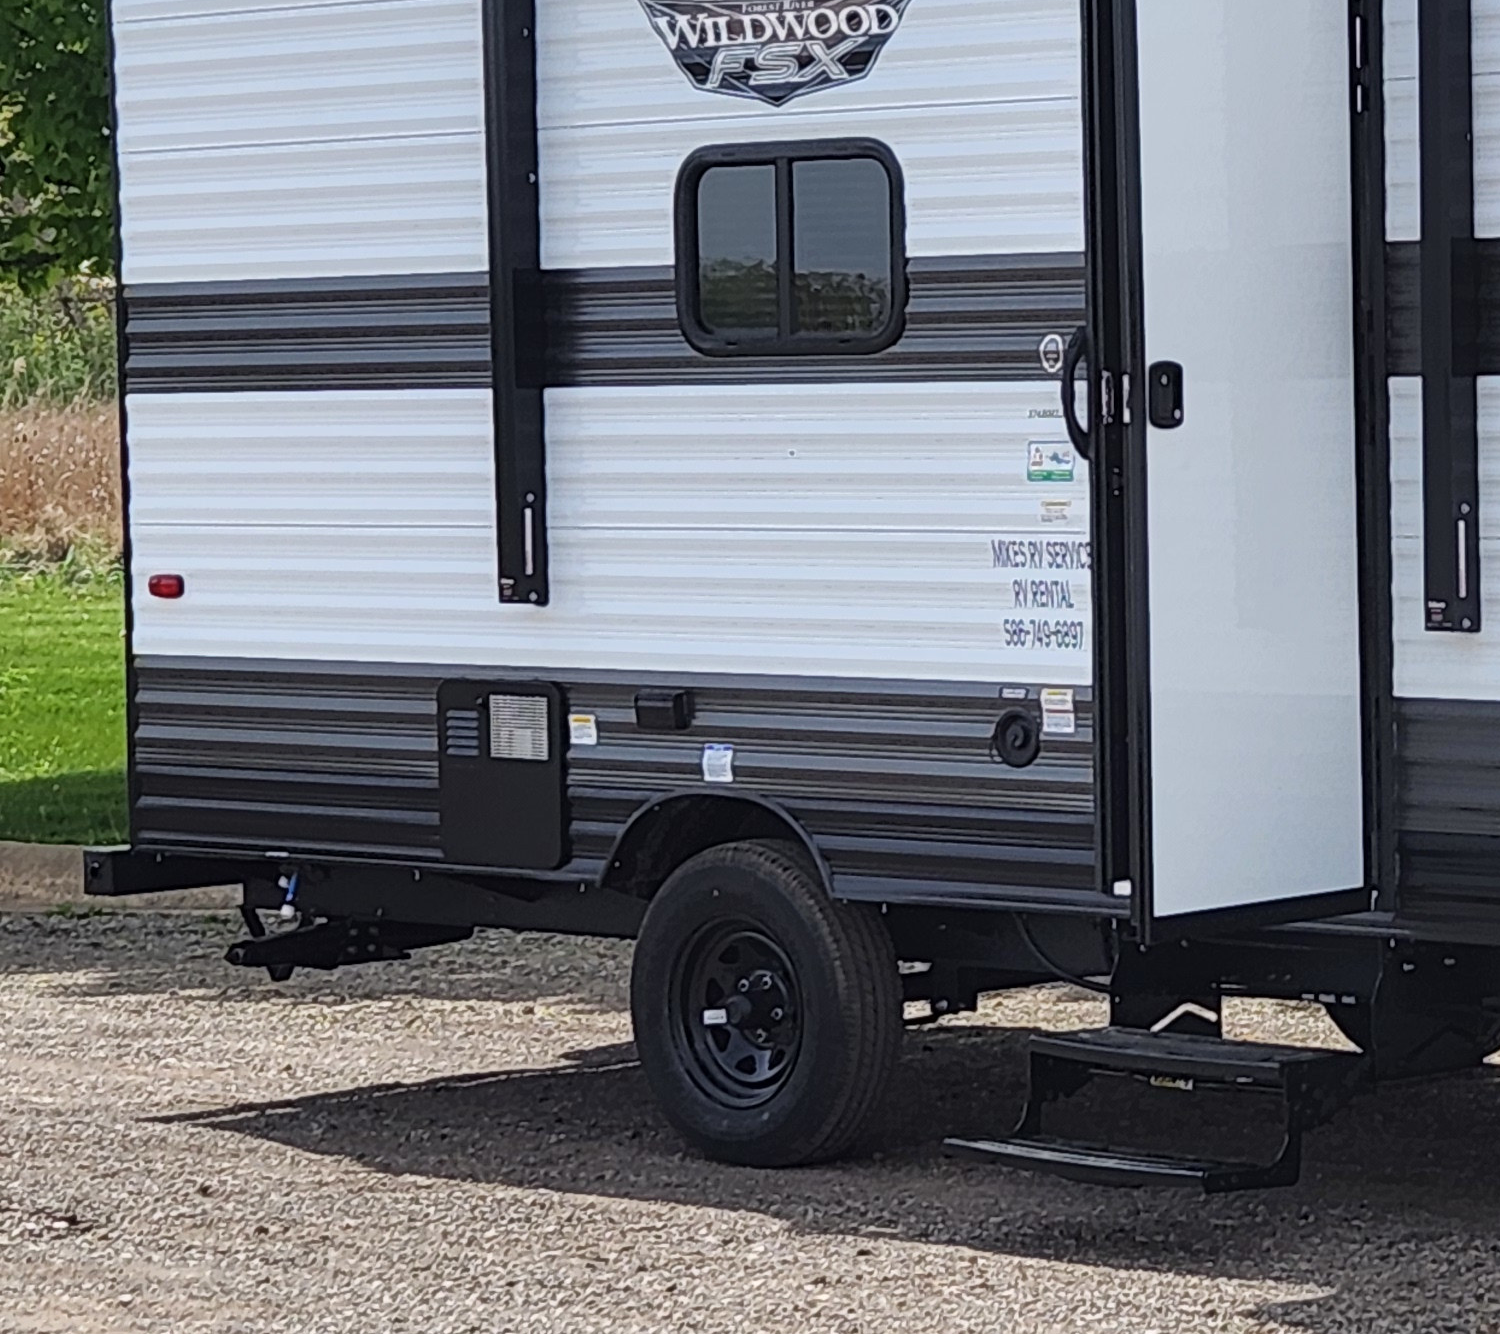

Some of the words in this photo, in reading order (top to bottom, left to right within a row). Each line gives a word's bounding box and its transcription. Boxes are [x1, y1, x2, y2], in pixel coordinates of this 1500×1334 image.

[653, 4, 899, 50] WILDWOOD
[707, 36, 869, 90] FSX
[991, 539, 1028, 568] MIKES
[1028, 540, 1044, 569] RV
[1012, 579, 1028, 608] RV
[1030, 579, 1074, 609] RENTAL
